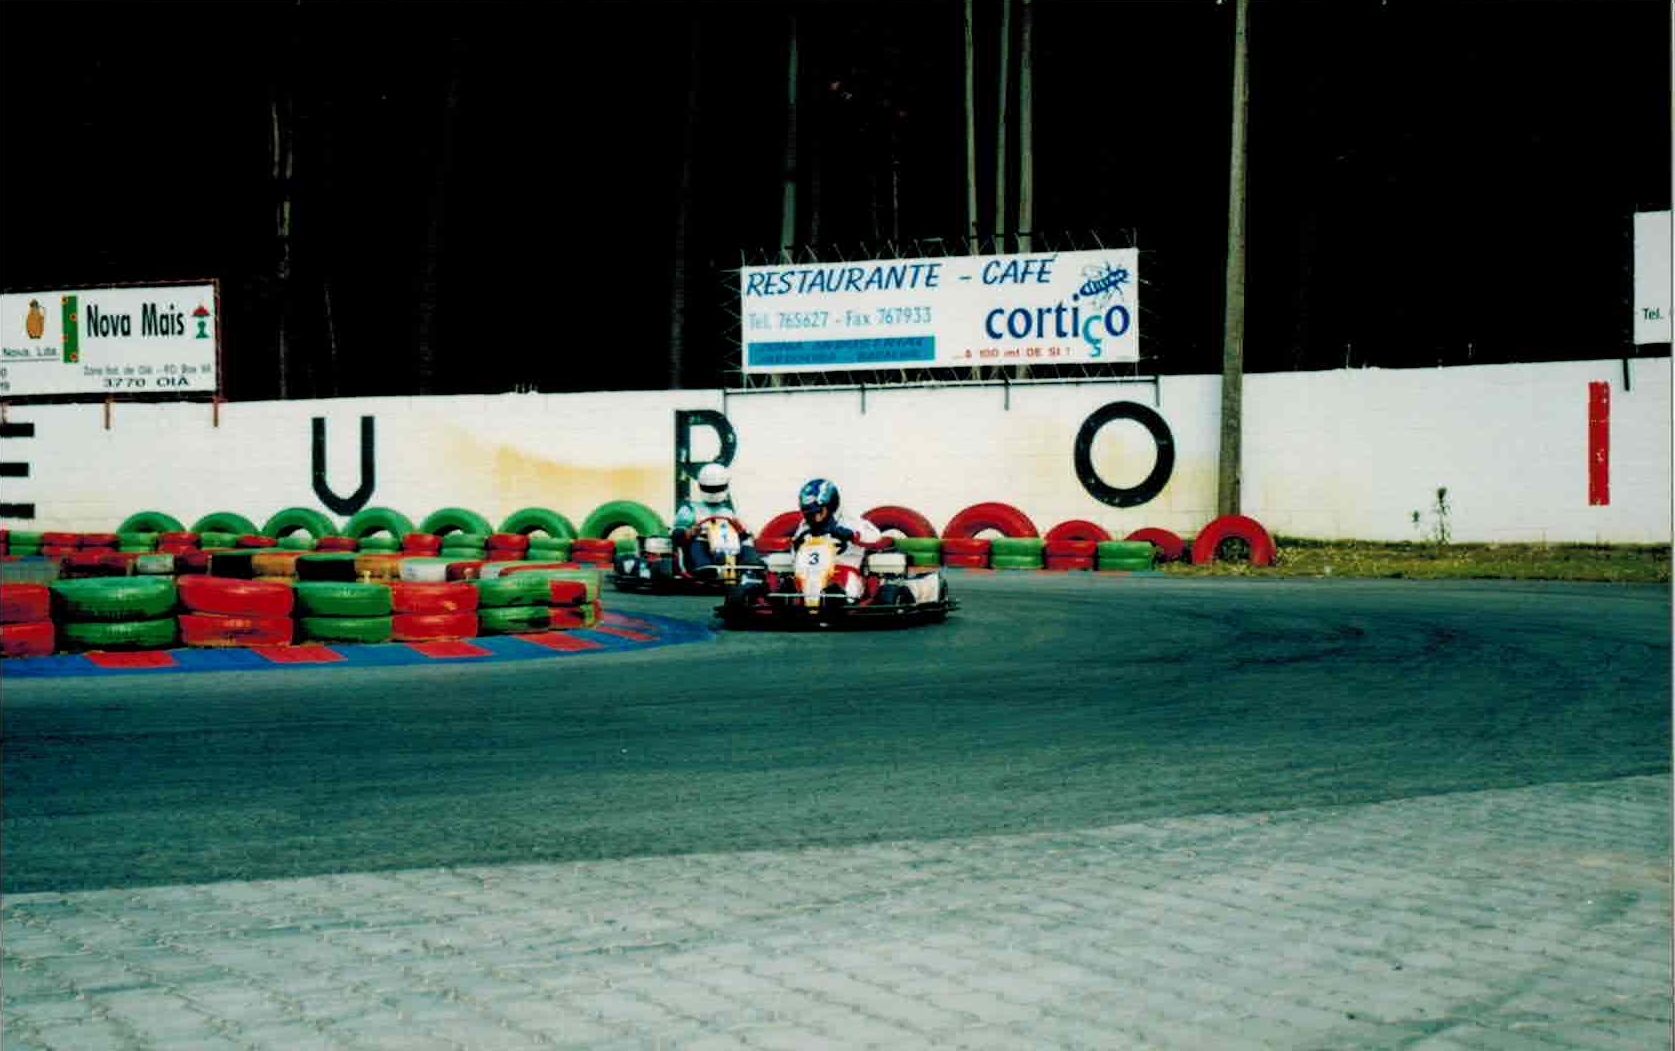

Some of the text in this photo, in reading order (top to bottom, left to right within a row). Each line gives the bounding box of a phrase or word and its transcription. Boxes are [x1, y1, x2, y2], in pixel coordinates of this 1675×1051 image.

[747, 263, 942, 297] RESTAURANTE
[983, 252, 1059, 285] CAFÉ
[86, 303, 185, 337] Nova Mais
[876, 306, 932, 324] 767933
[1641, 308, 1664, 319] Tel.
[986, 291, 1130, 358] cortiço
[104, 378, 146, 387] 3770
[809, 553, 819, 564] 3
